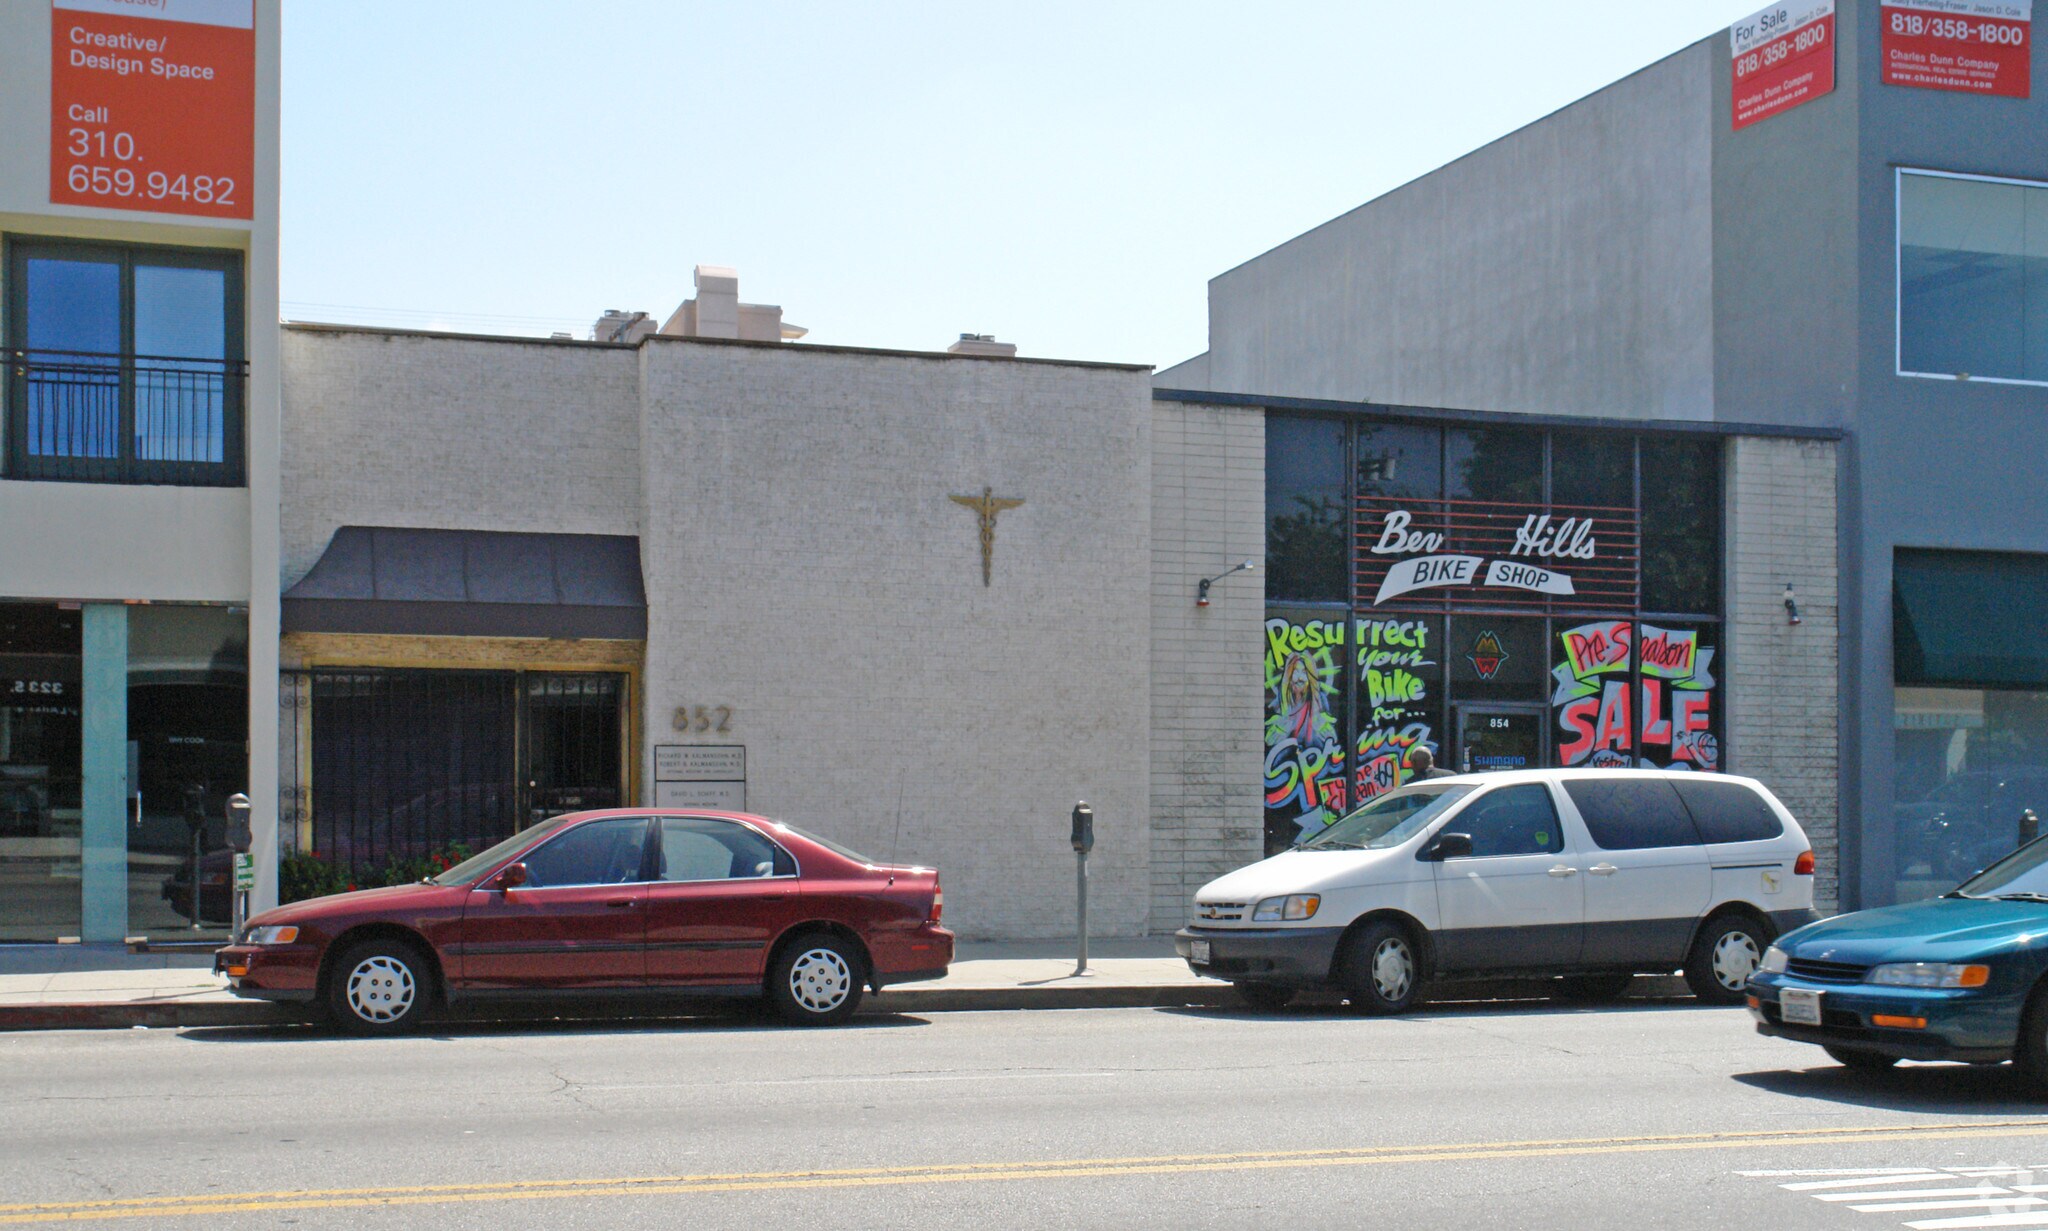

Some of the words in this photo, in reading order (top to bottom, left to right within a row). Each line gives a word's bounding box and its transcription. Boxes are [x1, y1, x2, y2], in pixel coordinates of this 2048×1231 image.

[1735, 25, 1755, 43] For
[1760, 9, 1787, 32] Sale
[2005, 7, 2021, 17] Cole
[69, 26, 167, 52] Creative/
[1890, 13, 2023, 46] 818/358-1800
[69, 49, 144, 76] Design
[150, 57, 215, 80] Space
[1737, 23, 1825, 77] 818/358-1800
[1890, 49, 1926, 63] Charles
[1929, 53, 1954, 65] Dunn
[1957, 56, 1999, 72] Company
[1738, 93, 1763, 110] Charles
[1764, 84, 1782, 99] Dunn
[1783, 71, 1814, 91] Company
[1891, 72, 1993, 89] www.charlesdunn.com
[68, 103, 109, 123] Call
[68, 127, 144, 162] 310.
[68, 163, 235, 205] 659.9482
[1371, 510, 1445, 554] Bev
[1509, 513, 1596, 559] Hills
[1412, 560, 1470, 585] BIKE
[1496, 564, 1549, 588] SHOP
[1265, 618, 1429, 669] Resurrect
[1357, 646, 1437, 682] your
[1367, 668, 1426, 708] Bike
[672, 705, 732, 733] 852
[1490, 718, 1509, 728] 854
[1559, 679, 1710, 766] SALE
[1474, 755, 1526, 767] SHIMANO
